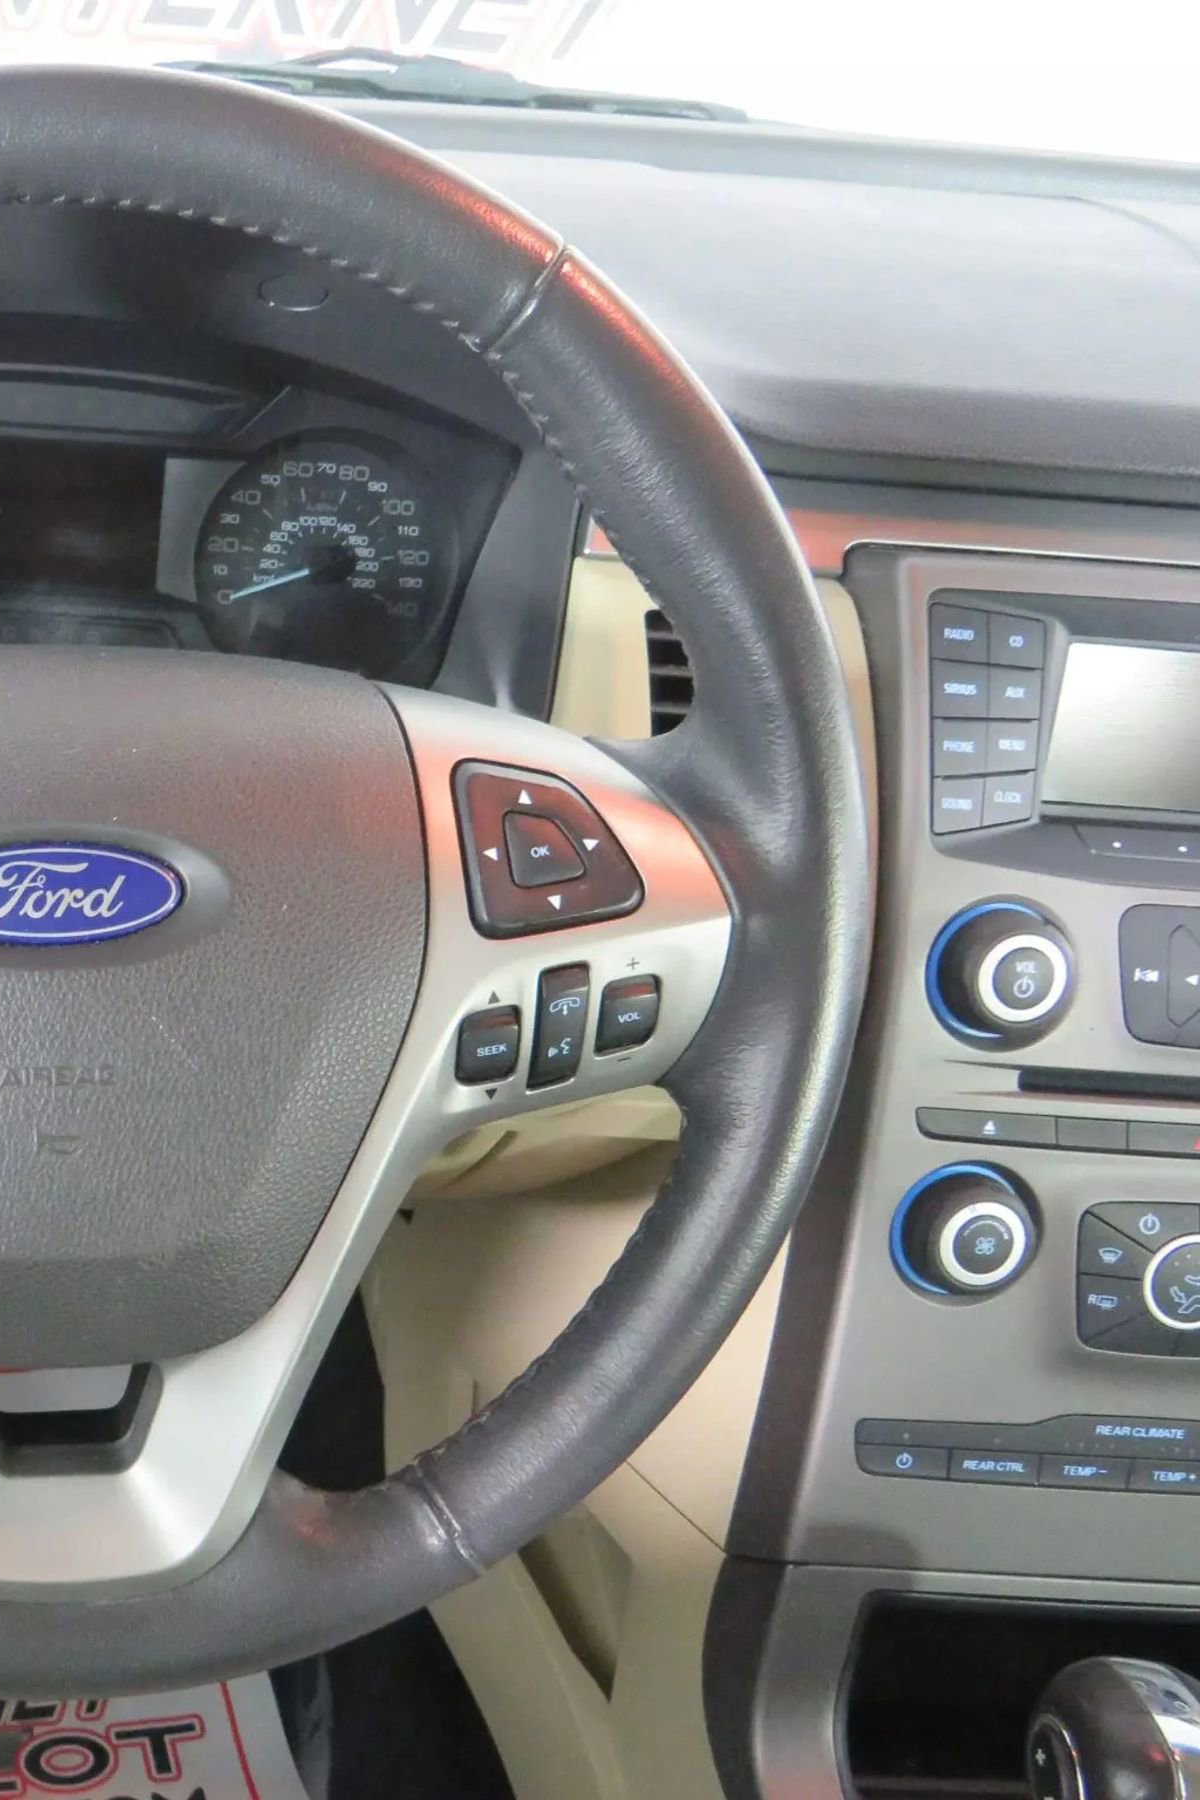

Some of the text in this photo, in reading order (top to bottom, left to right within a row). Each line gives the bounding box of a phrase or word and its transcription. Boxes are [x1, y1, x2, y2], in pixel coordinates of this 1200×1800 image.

[283, 461, 313, 477] 60
[315, 463, 337, 474] 70
[339, 465, 370, 482] 80
[261, 474, 281, 486] 50
[368, 481, 388, 493] 90
[231, 490, 261, 505] 40
[381, 500, 415, 516] 100
[220, 513, 240, 524] 30
[299, 516, 318, 526] 100
[397, 525, 419, 536] 110
[207, 537, 239, 552] 20
[262, 544, 281, 554] 40
[397, 550, 430, 566] 120
[212, 564, 228, 575] 10
[397, 577, 423, 589] 130
[530, 845, 550, 859] OK
[1015, 961, 1037, 974] VOL
[617, 1011, 642, 1024] VOL
[476, 1043, 507, 1058] SEEK
[1094, 1424, 1186, 1440] REAR CLIMATE
[962, 1459, 1026, 1473] REAR CTRL
[1062, 1465, 1098, 1478] TEMP
[1151, 1470, 1187, 1483] TEMP
